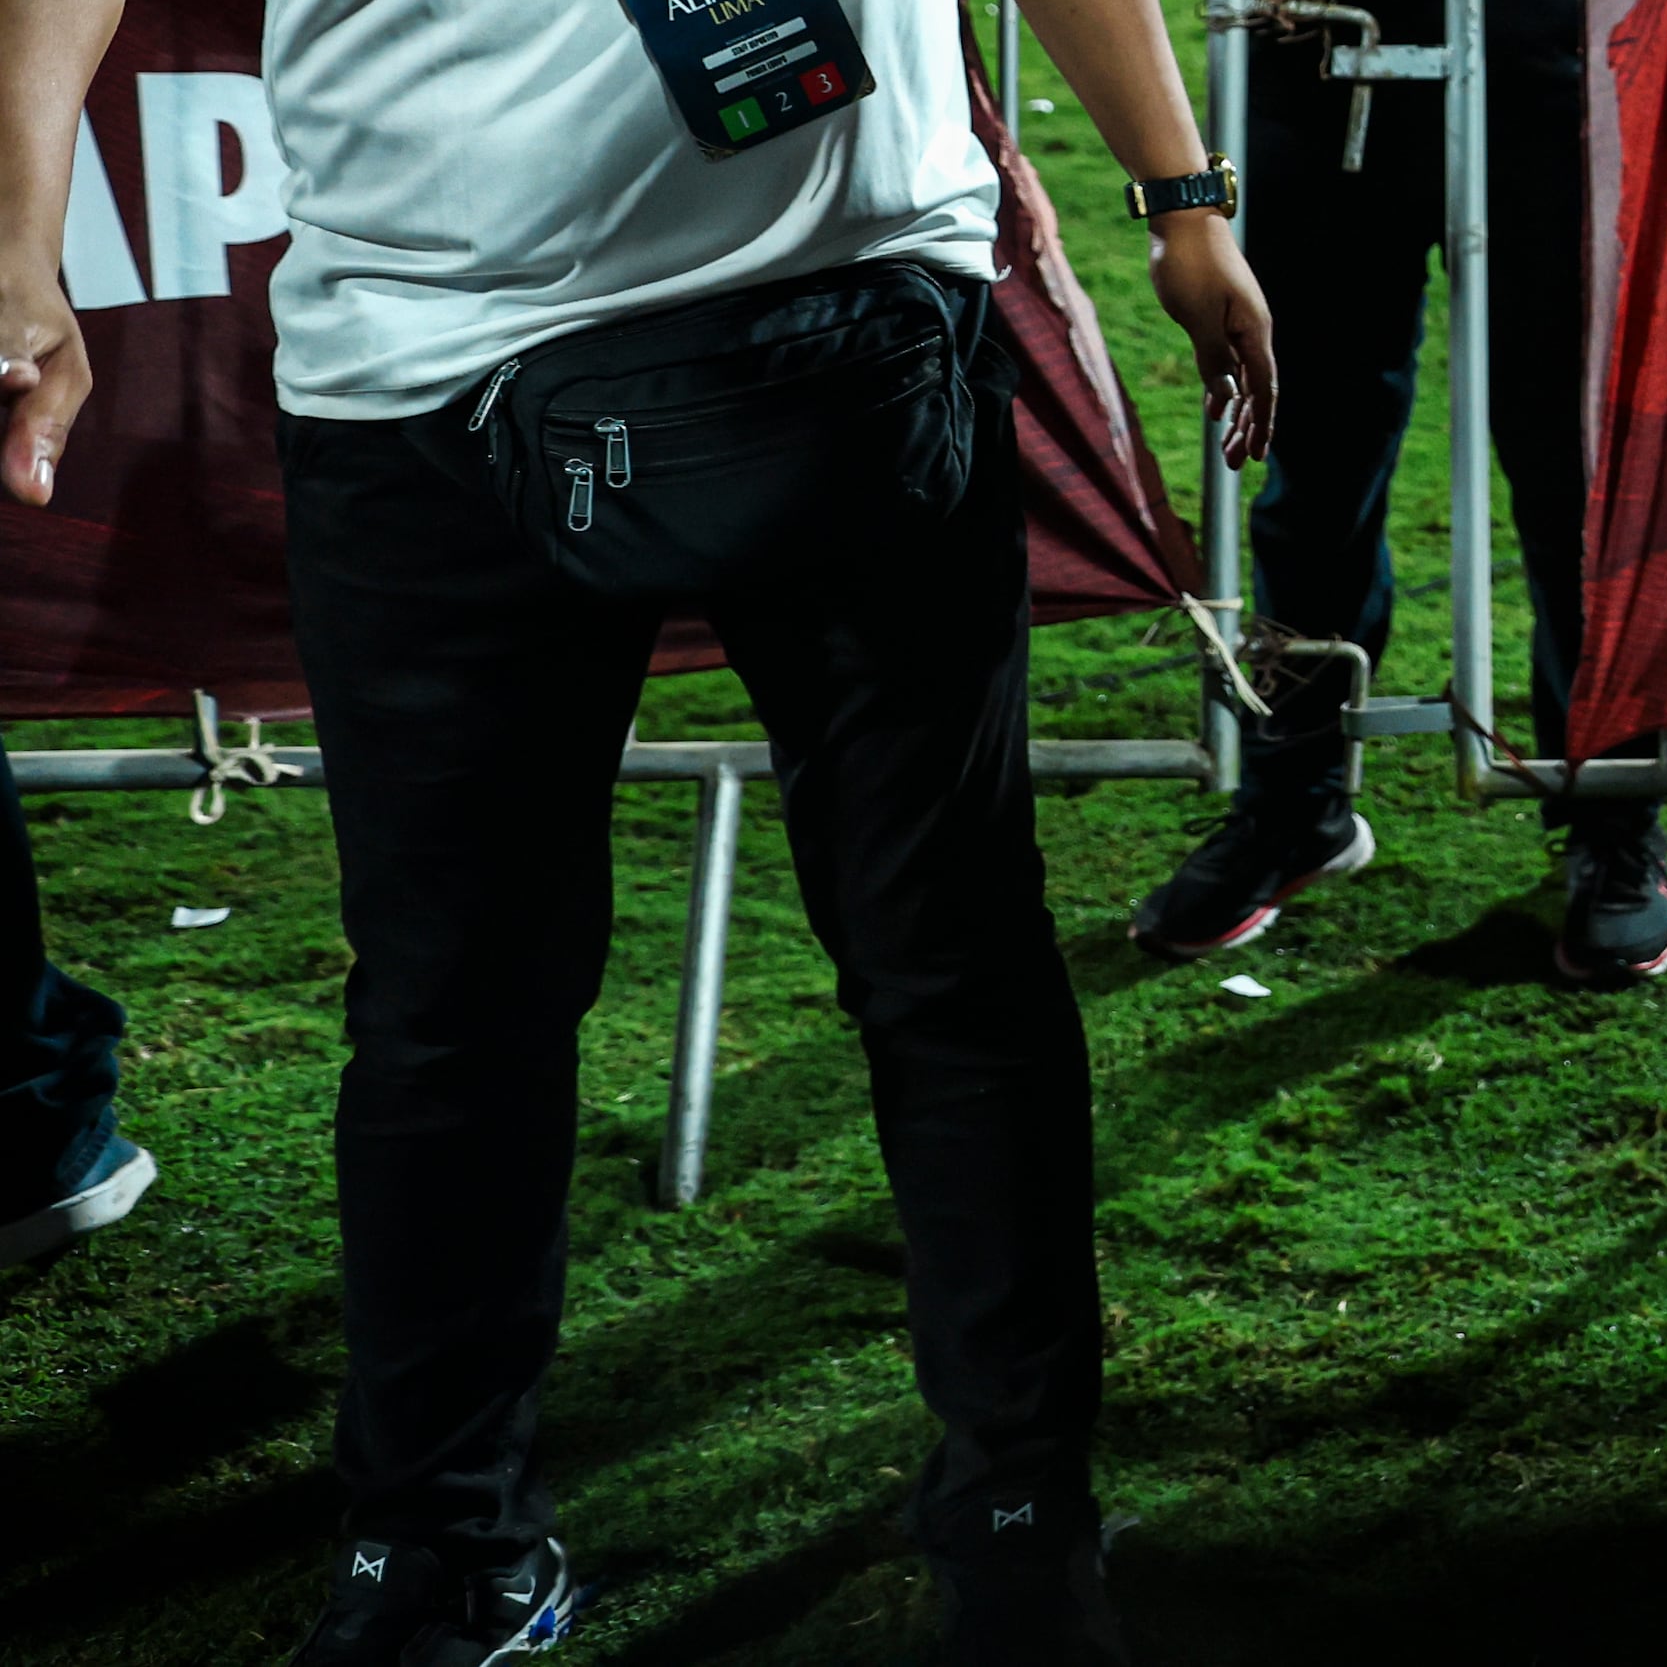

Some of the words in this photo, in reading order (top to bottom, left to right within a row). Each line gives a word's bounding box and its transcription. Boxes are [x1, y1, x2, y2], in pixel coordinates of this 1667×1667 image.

[738, 110, 750, 129] 1
[775, 91, 793, 112] 2
[816, 72, 833, 94] 3
